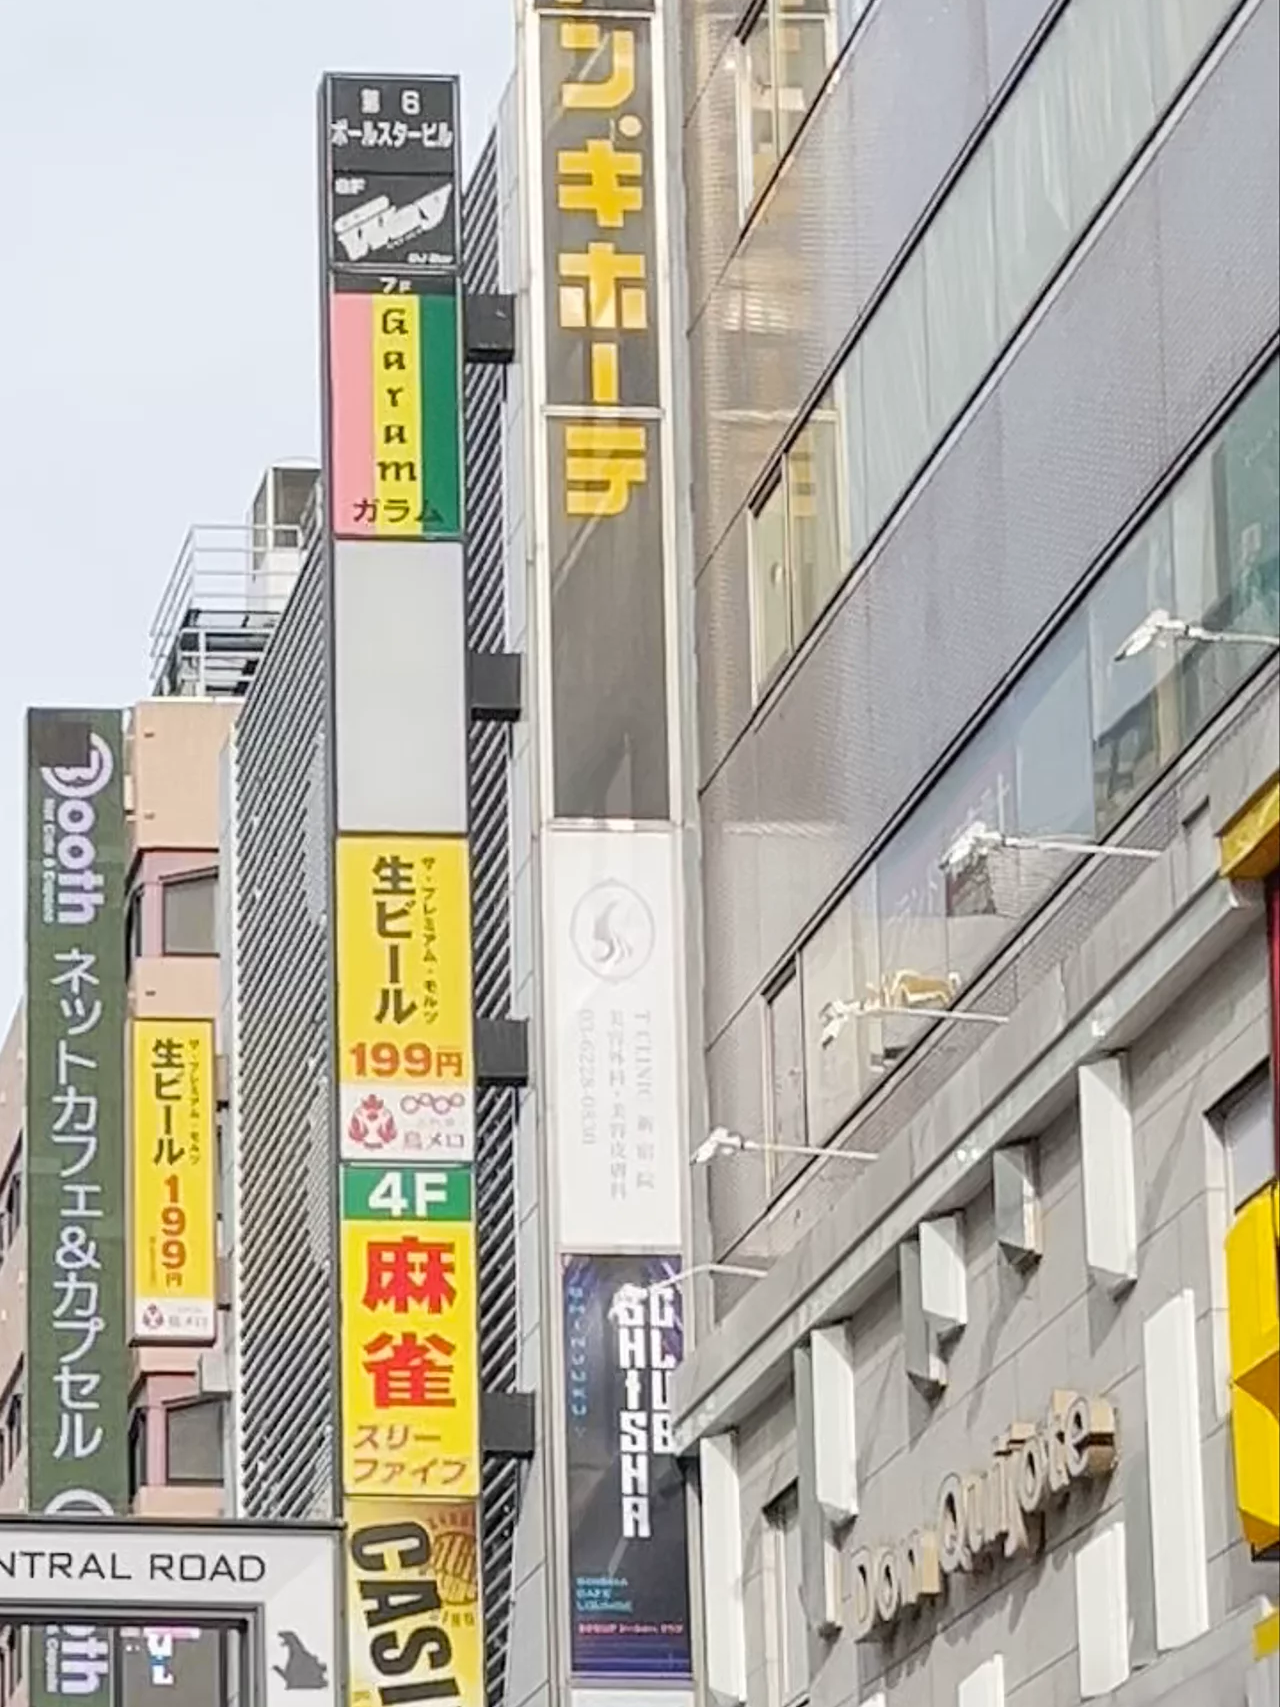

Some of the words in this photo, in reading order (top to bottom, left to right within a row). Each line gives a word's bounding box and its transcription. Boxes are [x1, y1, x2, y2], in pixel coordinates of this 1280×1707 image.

[352, 497, 444, 525] ガラム
[372, 855, 417, 1025] 生ビール
[349, 1042, 463, 1079] 199円
[151, 1038, 185, 1166] 生ビール
[368, 1172, 447, 1218] 4F
[160, 1173, 187, 1288] 199円
[361, 1236, 456, 1408] 麻雀
[354, 1424, 442, 1450] スリー
[352, 1457, 466, 1484] ファイブ
[851, 1523, 943, 1644] Don
[941, 1391, 1095, 1575] Quijote
[148, 1551, 264, 1582] ROAD
